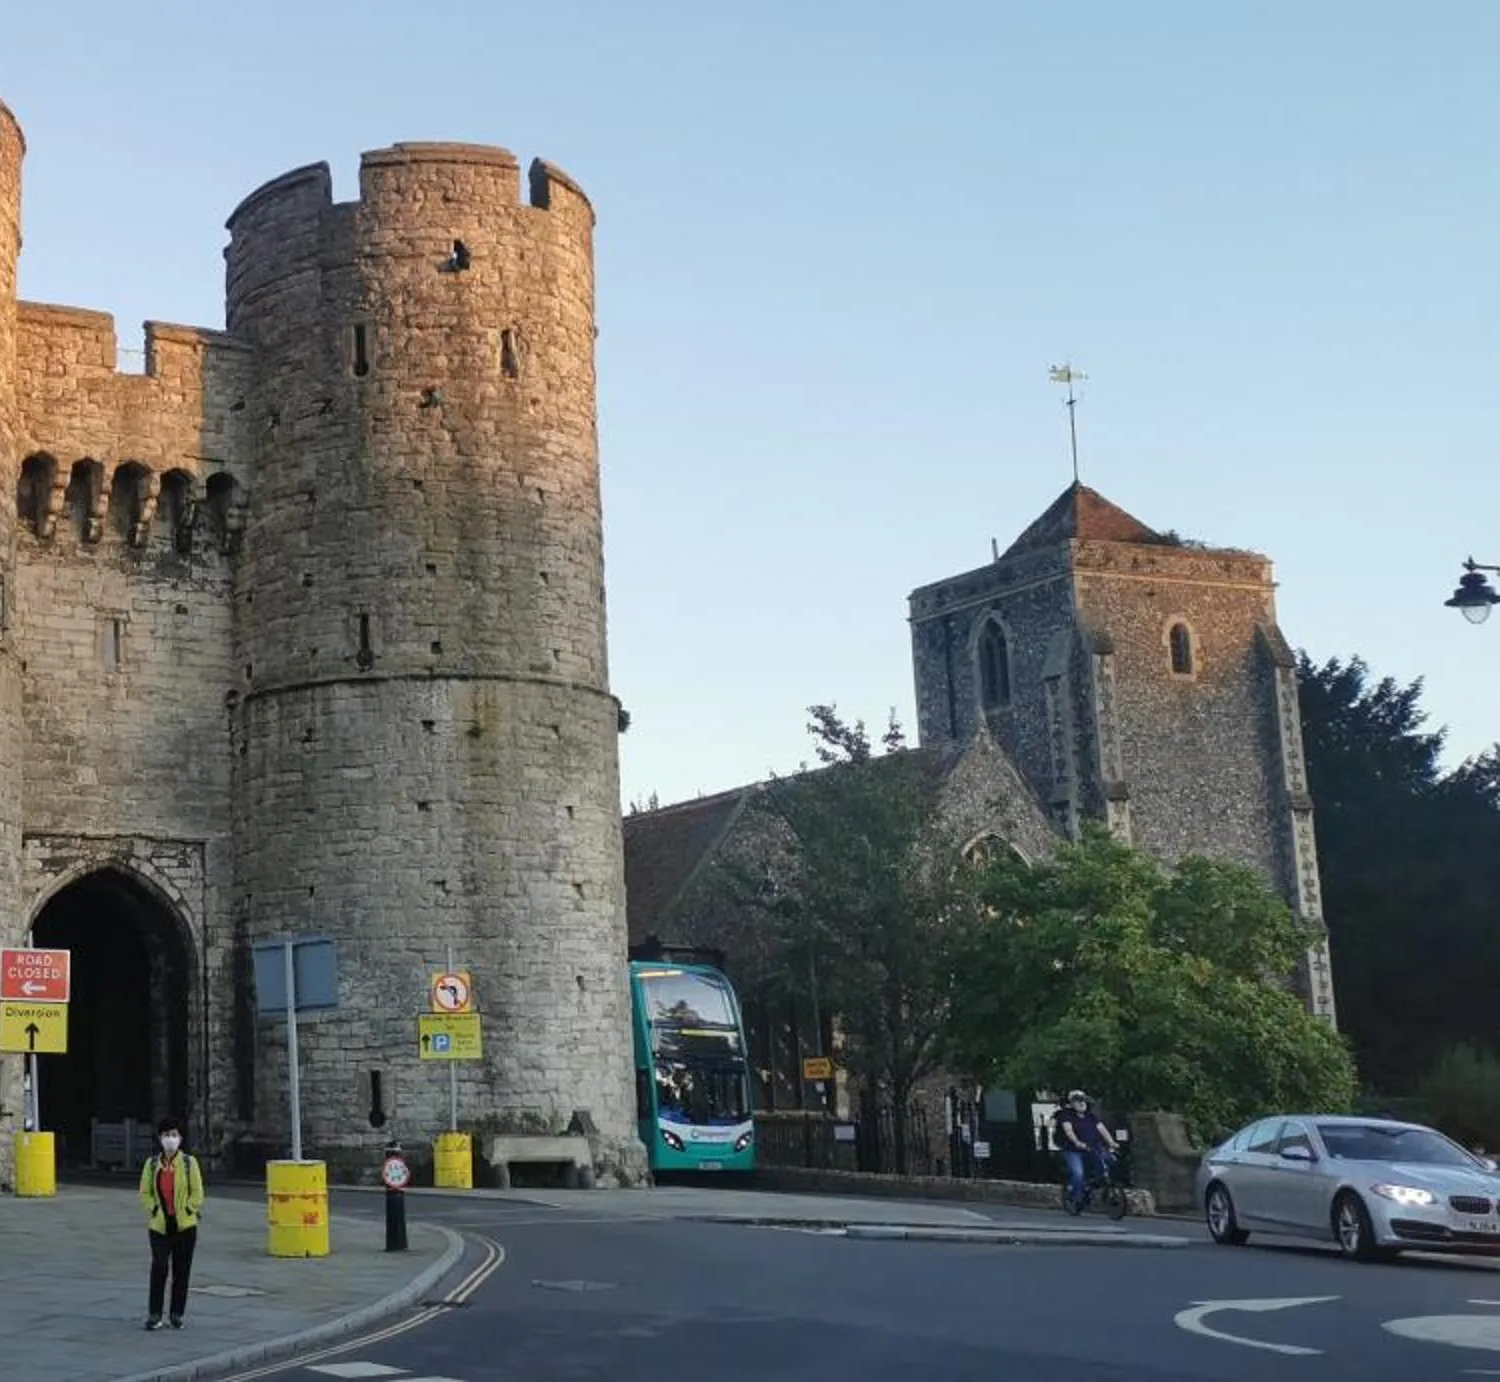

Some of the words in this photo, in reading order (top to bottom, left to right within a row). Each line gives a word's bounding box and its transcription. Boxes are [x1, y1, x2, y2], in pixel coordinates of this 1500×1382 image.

[16, 954, 52, 966] ROAD
[7, 967, 60, 979] CLOSED
[5, 1006, 61, 1017] Diversion
[435, 1036, 448, 1050] P
